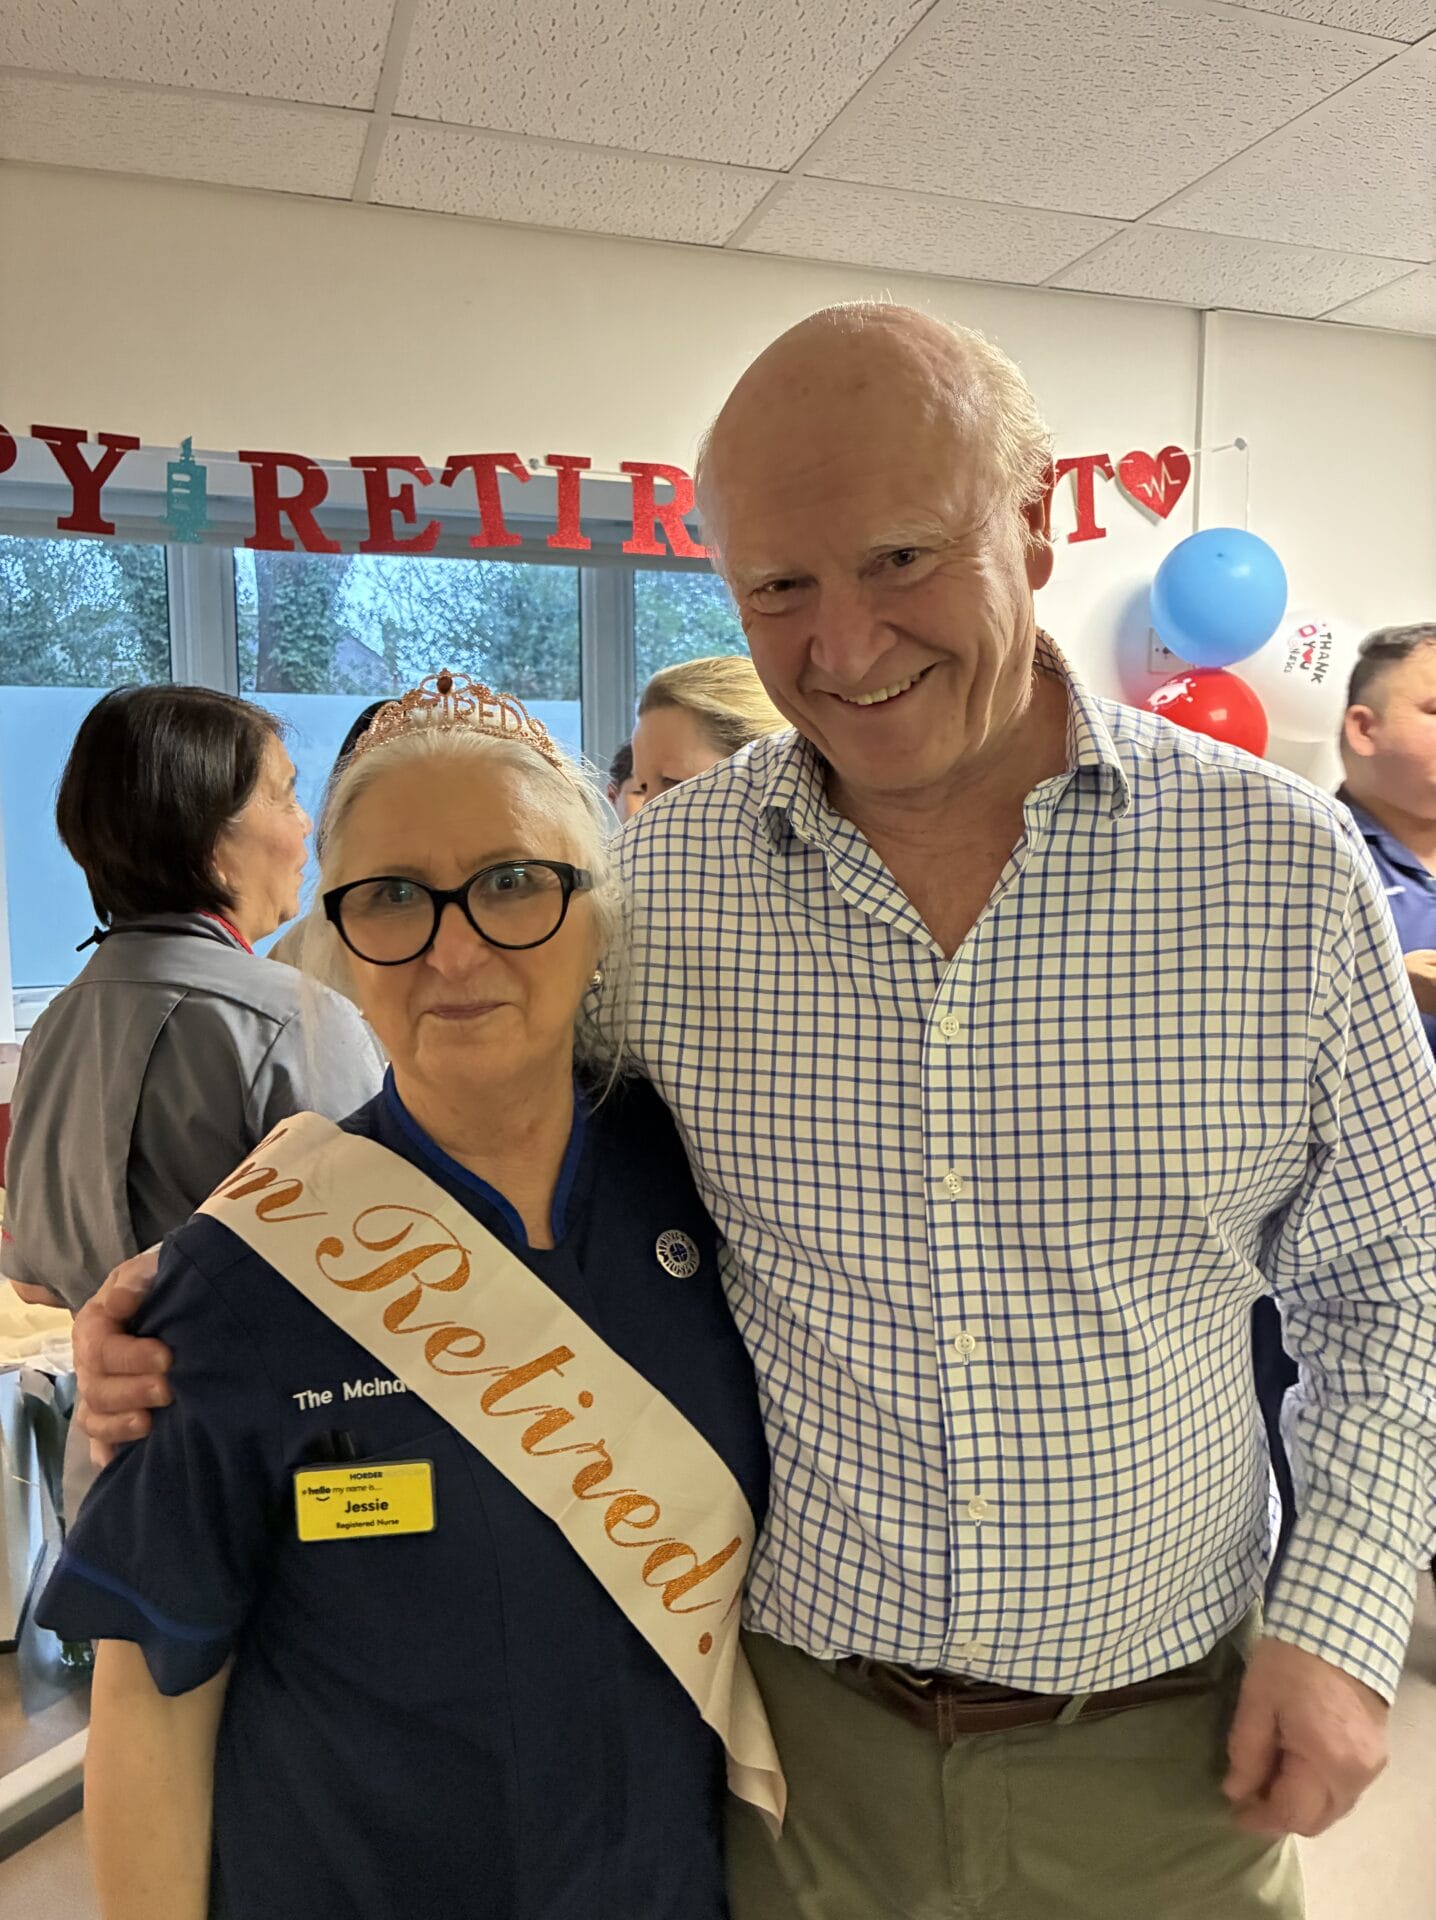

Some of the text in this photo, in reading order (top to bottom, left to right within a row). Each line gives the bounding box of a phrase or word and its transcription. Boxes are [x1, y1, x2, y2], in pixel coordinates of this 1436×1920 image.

[1311, 632, 1332, 684] THANK
[292, 1389, 333, 1410] The
[333, 1487, 345, 1495] my
[344, 1498, 389, 1513] Jessie
[336, 1520, 375, 1530] Registered
